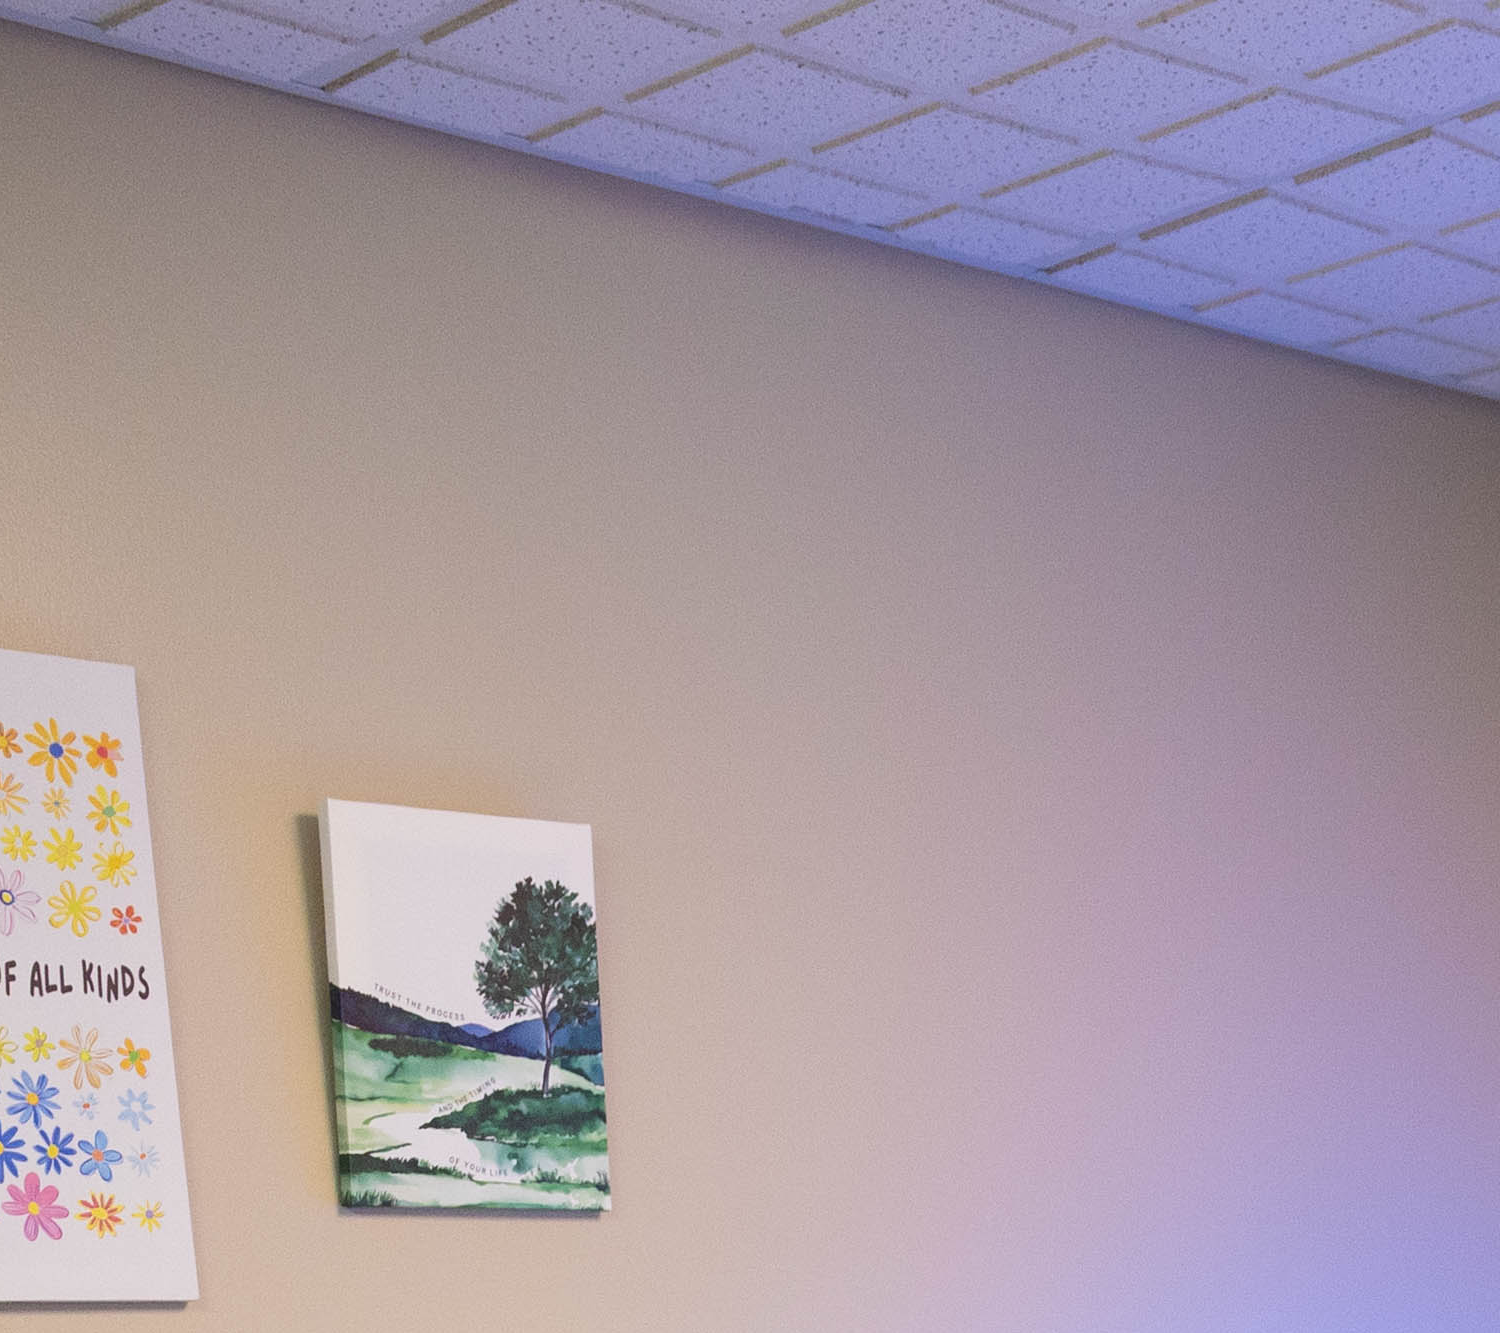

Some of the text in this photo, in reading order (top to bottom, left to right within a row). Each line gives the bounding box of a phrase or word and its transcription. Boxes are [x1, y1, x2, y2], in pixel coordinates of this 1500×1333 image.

[30, 961, 72, 996] ALL
[81, 959, 150, 1003] KINDS
[374, 983, 465, 1021] TRUST THE PROCESS
[438, 1102, 454, 1114] AND
[468, 1077, 496, 1102] TIMING
[449, 1156, 459, 1165] OF
[464, 1160, 486, 1175] YOUR
